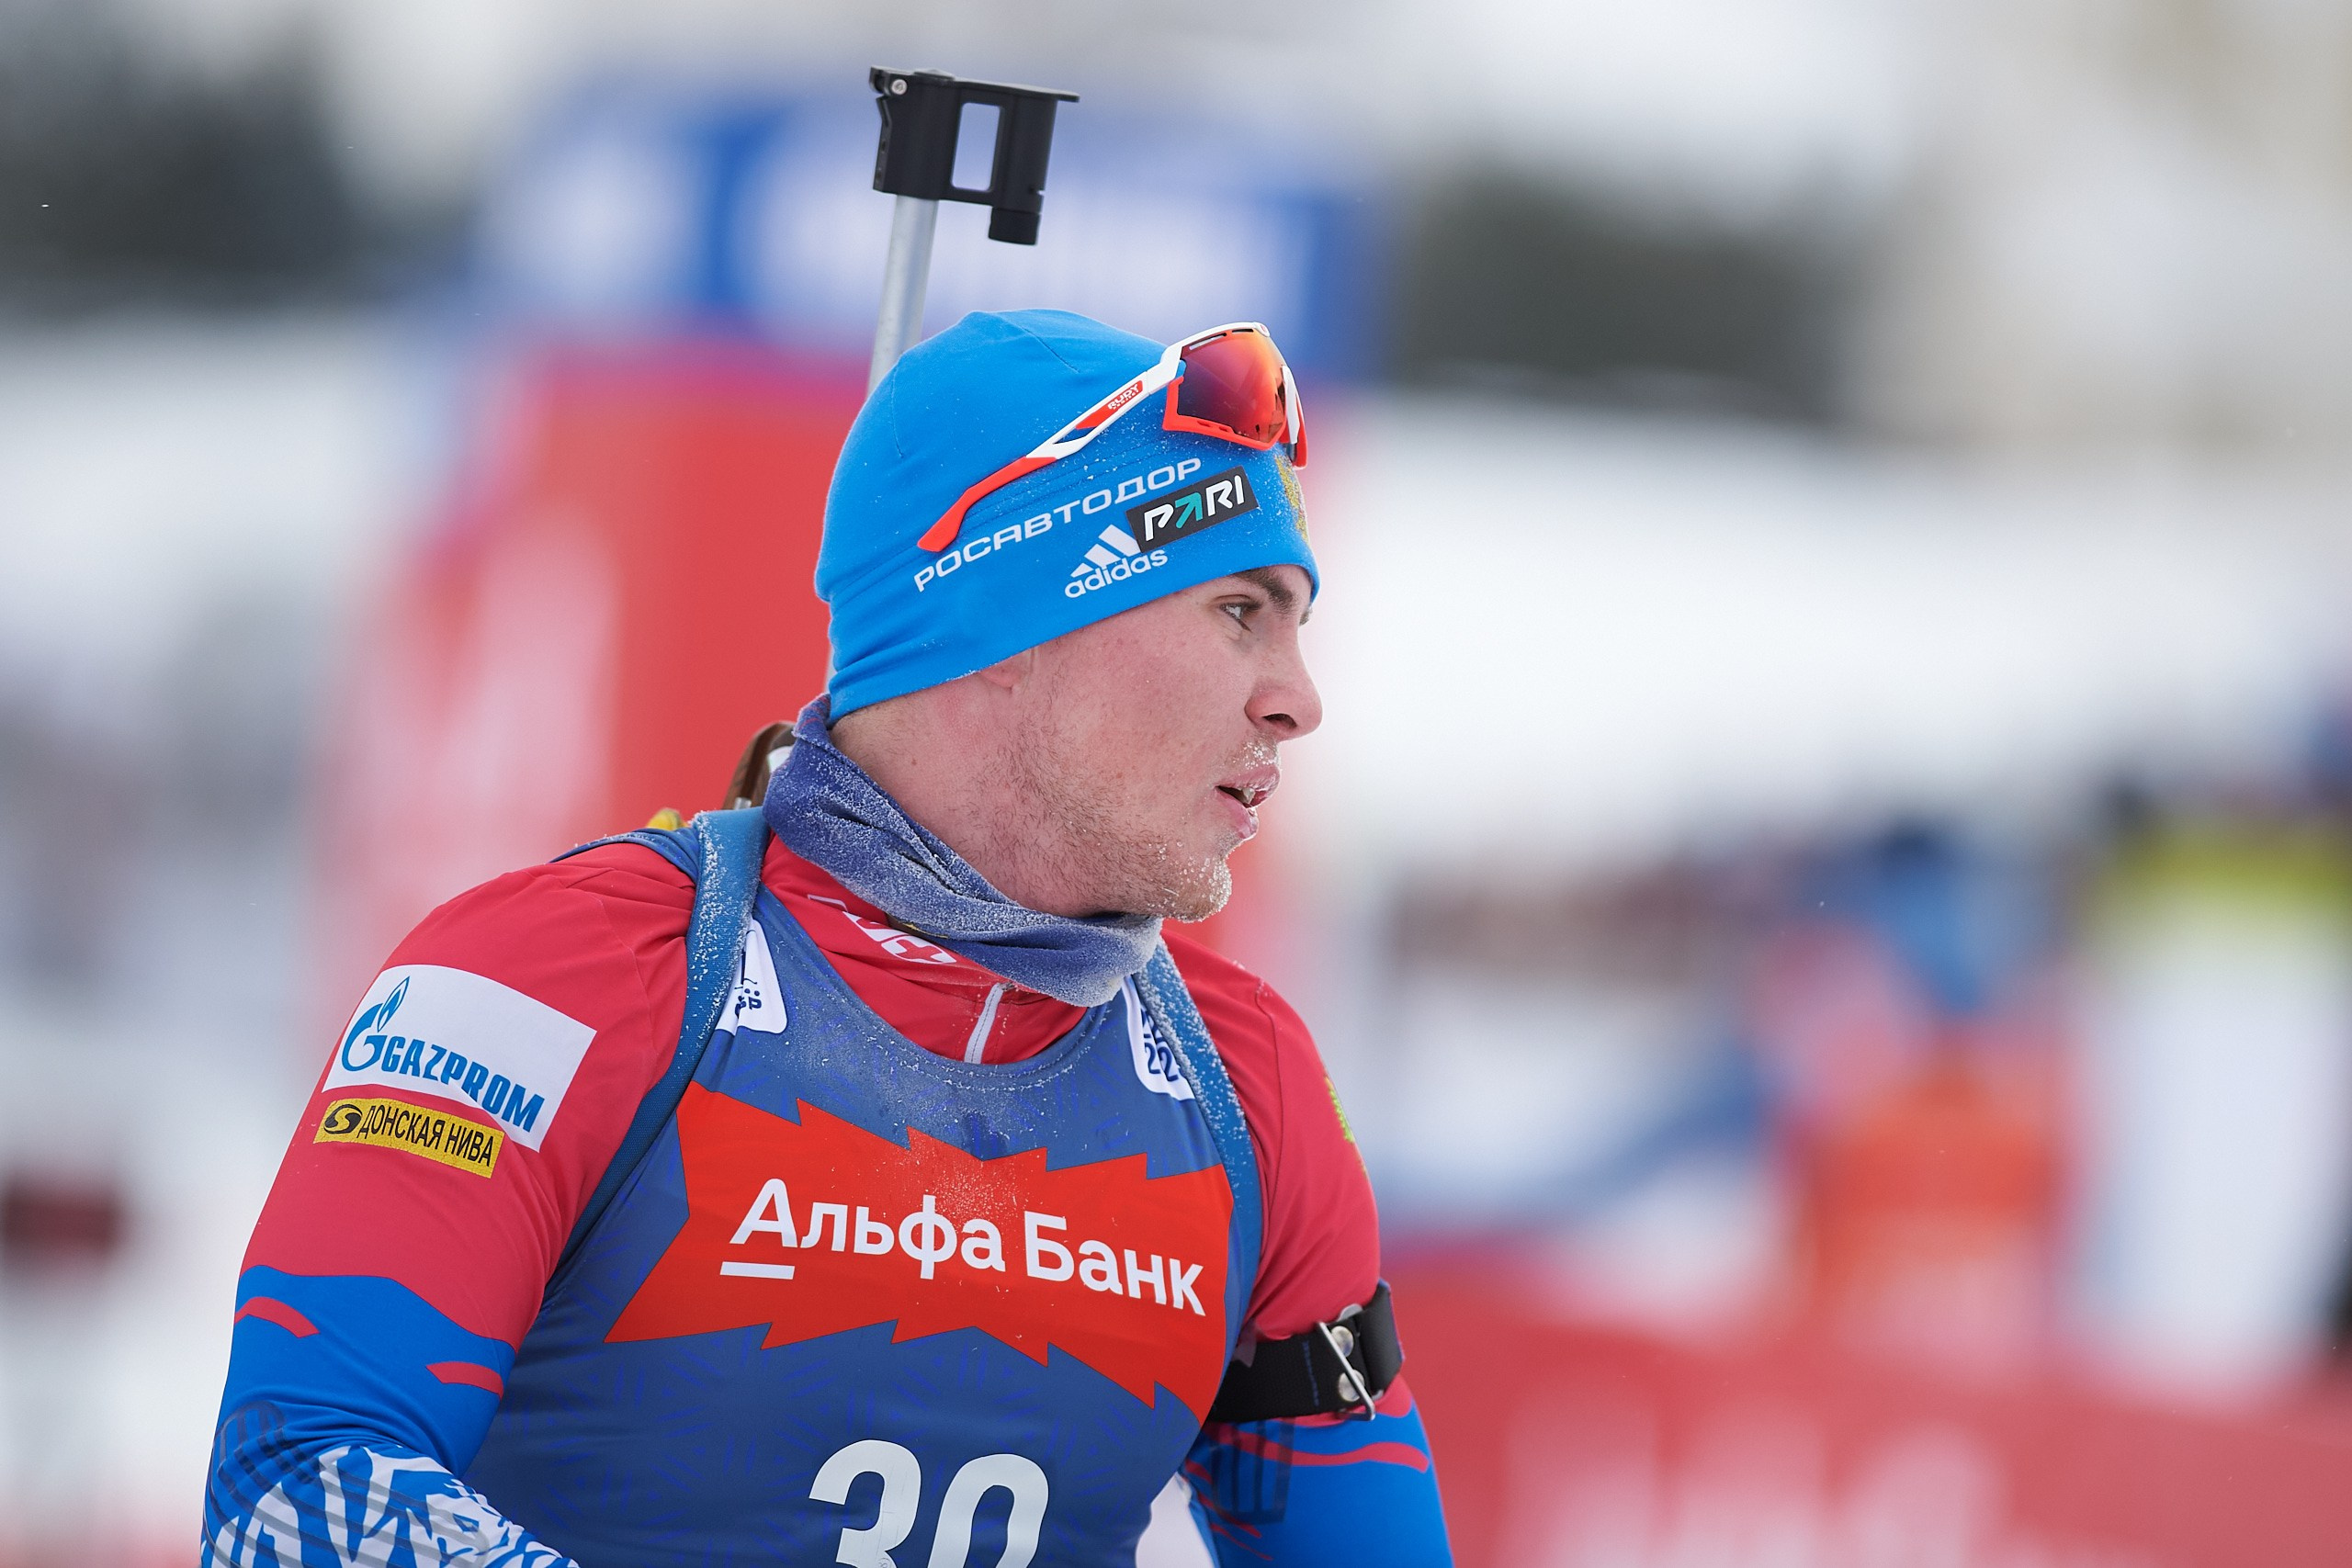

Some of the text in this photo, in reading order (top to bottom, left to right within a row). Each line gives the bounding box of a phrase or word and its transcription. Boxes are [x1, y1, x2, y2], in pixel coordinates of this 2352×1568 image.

[914, 457, 1202, 592] РОСАВТОДОР
[1065, 549, 1169, 600] adidas
[381, 1036, 545, 1133] GAZPROM
[357, 1104, 495, 1167] ДОНСКАЯ НИВА
[729, 1178, 1207, 1317] Альфа Банк
